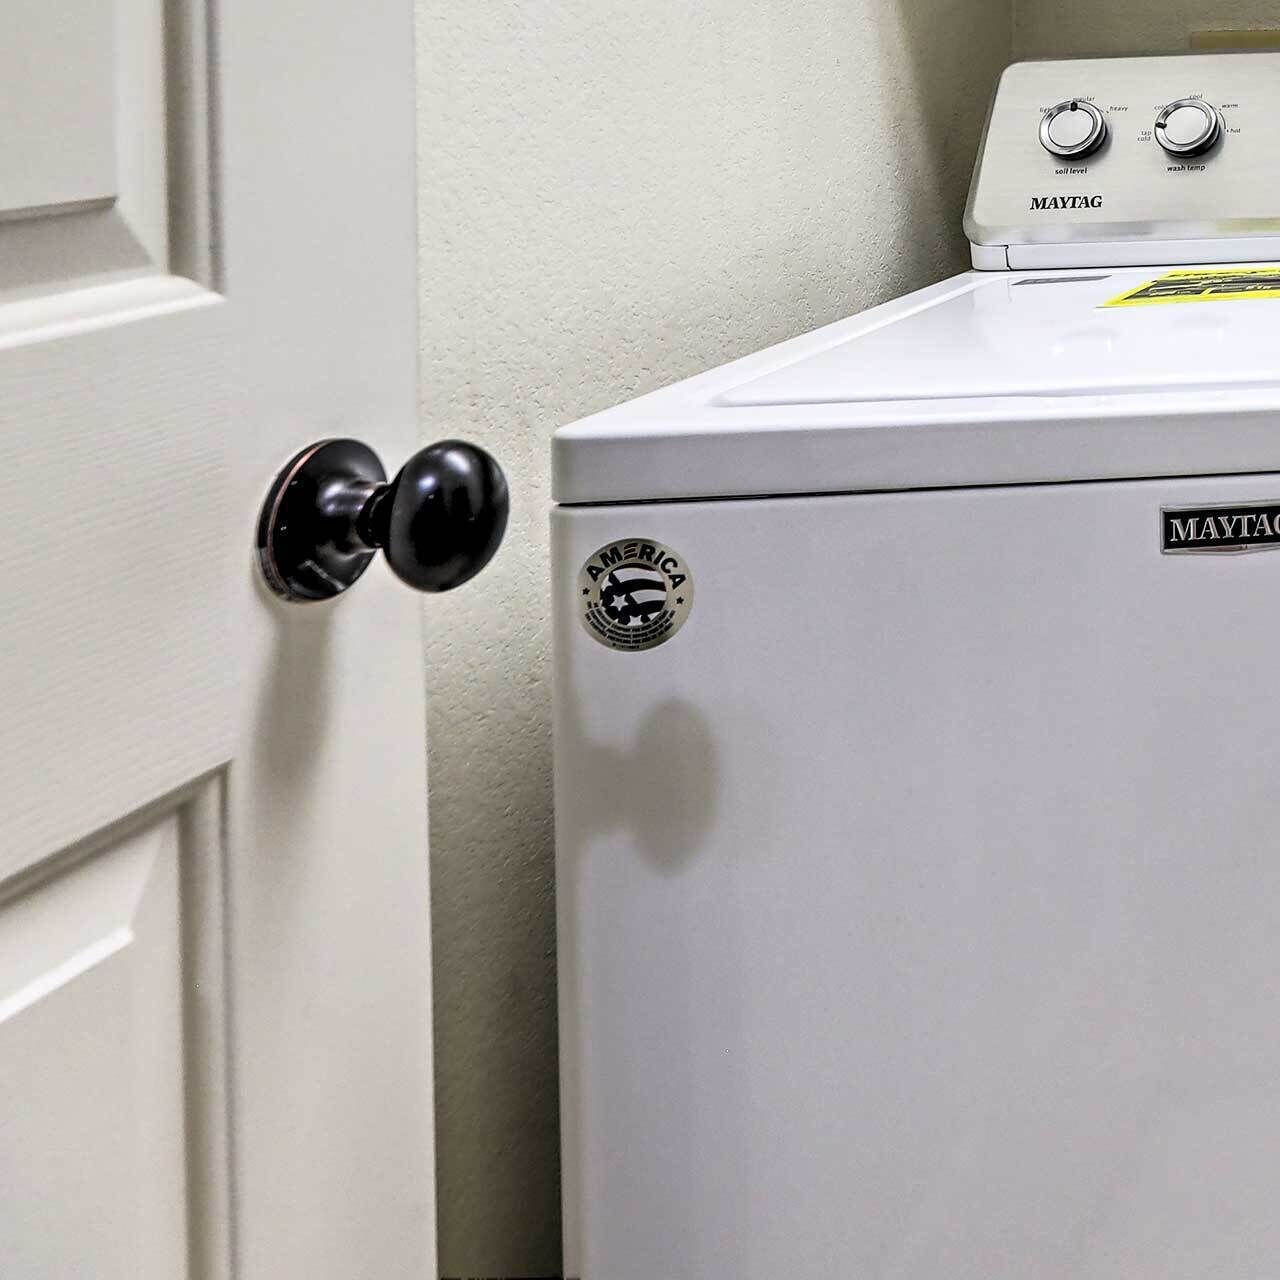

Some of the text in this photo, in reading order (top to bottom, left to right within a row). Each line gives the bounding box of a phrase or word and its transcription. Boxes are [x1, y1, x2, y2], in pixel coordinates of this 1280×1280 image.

[1055, 167, 1068, 175] soil
[1167, 163, 1206, 172] wash temp
[1029, 195, 1103, 210] MAYTAG
[586, 542, 687, 590] AMERICA
